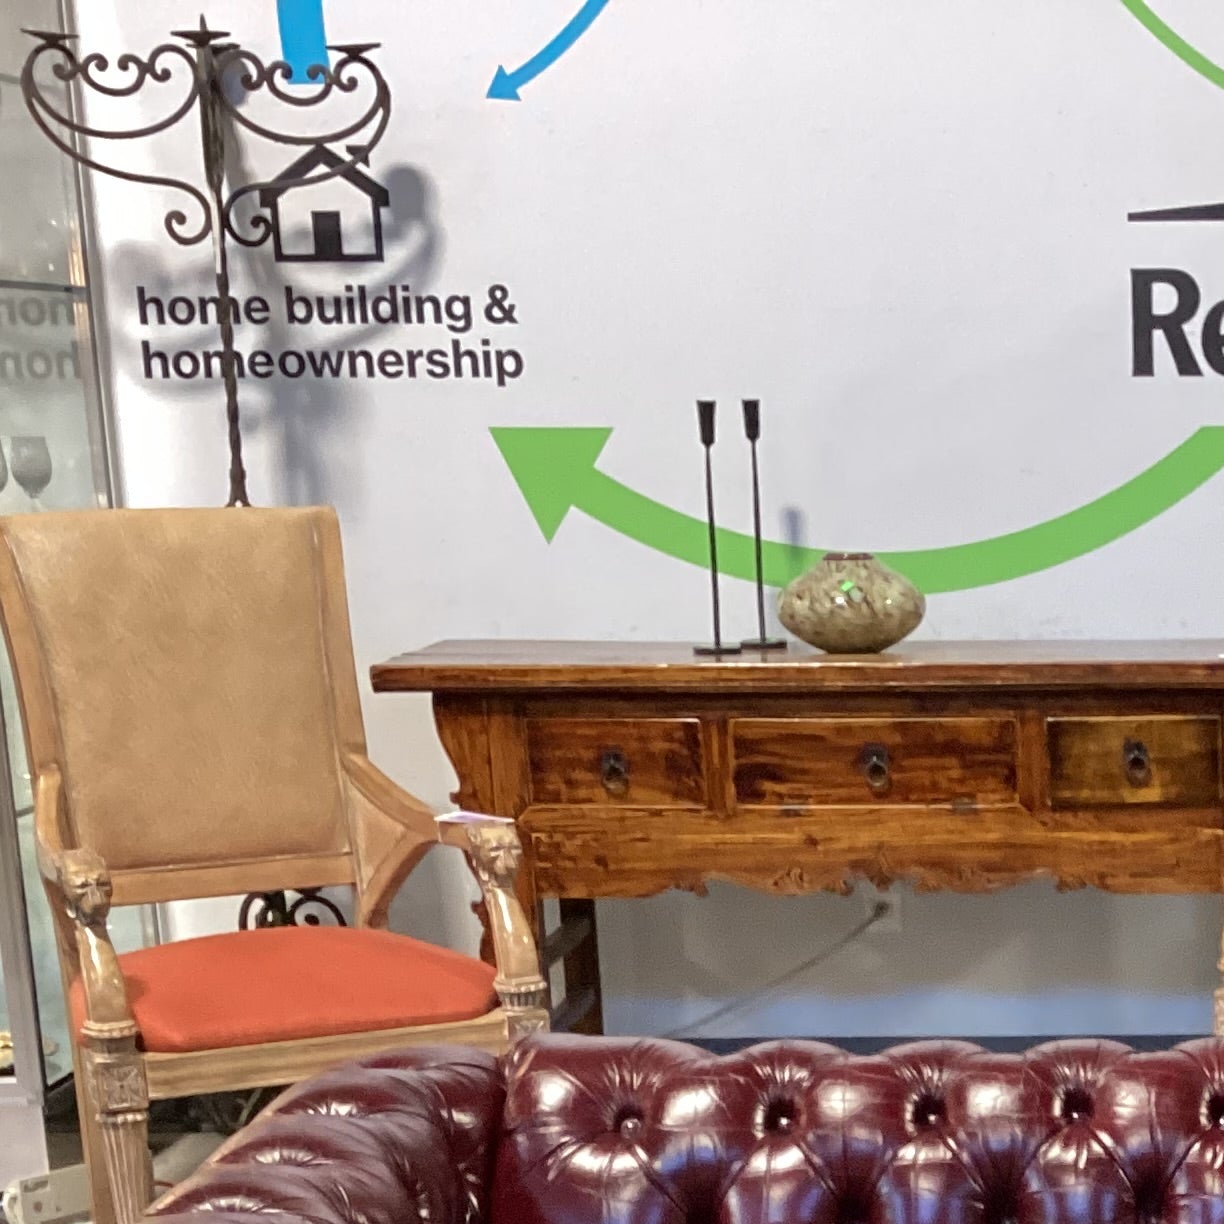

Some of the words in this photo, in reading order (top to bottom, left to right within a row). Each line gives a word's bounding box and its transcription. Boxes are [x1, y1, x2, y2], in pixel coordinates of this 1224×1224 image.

[136, 286, 270, 325] home
[285, 285, 472, 331] building
[484, 283, 518, 325] &
[142, 339, 523, 386] homeownership
